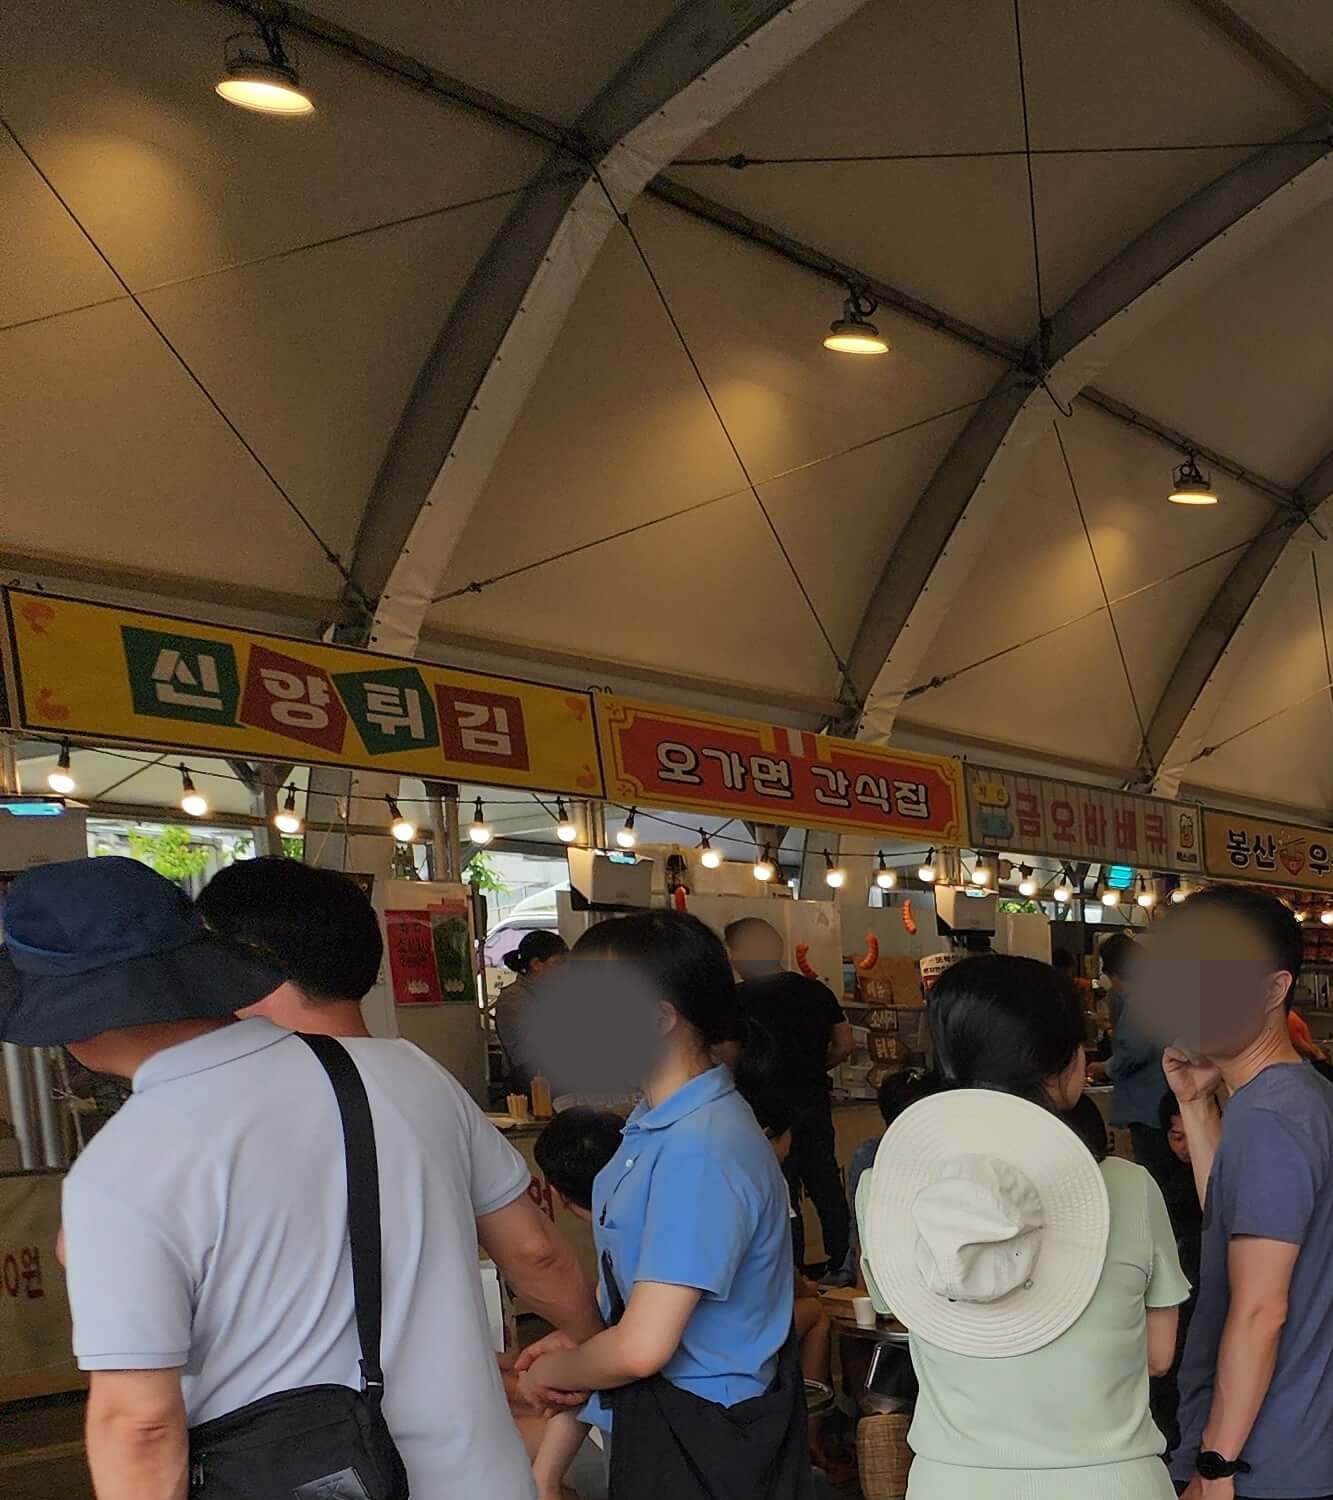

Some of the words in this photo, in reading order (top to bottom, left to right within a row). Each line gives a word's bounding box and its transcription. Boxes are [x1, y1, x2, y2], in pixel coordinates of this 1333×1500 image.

[152, 647, 512, 756] 신양튀김
[656, 742, 792, 799] 오가면
[810, 766, 929, 819] 간식집
[1225, 829, 1279, 871] 봉산
